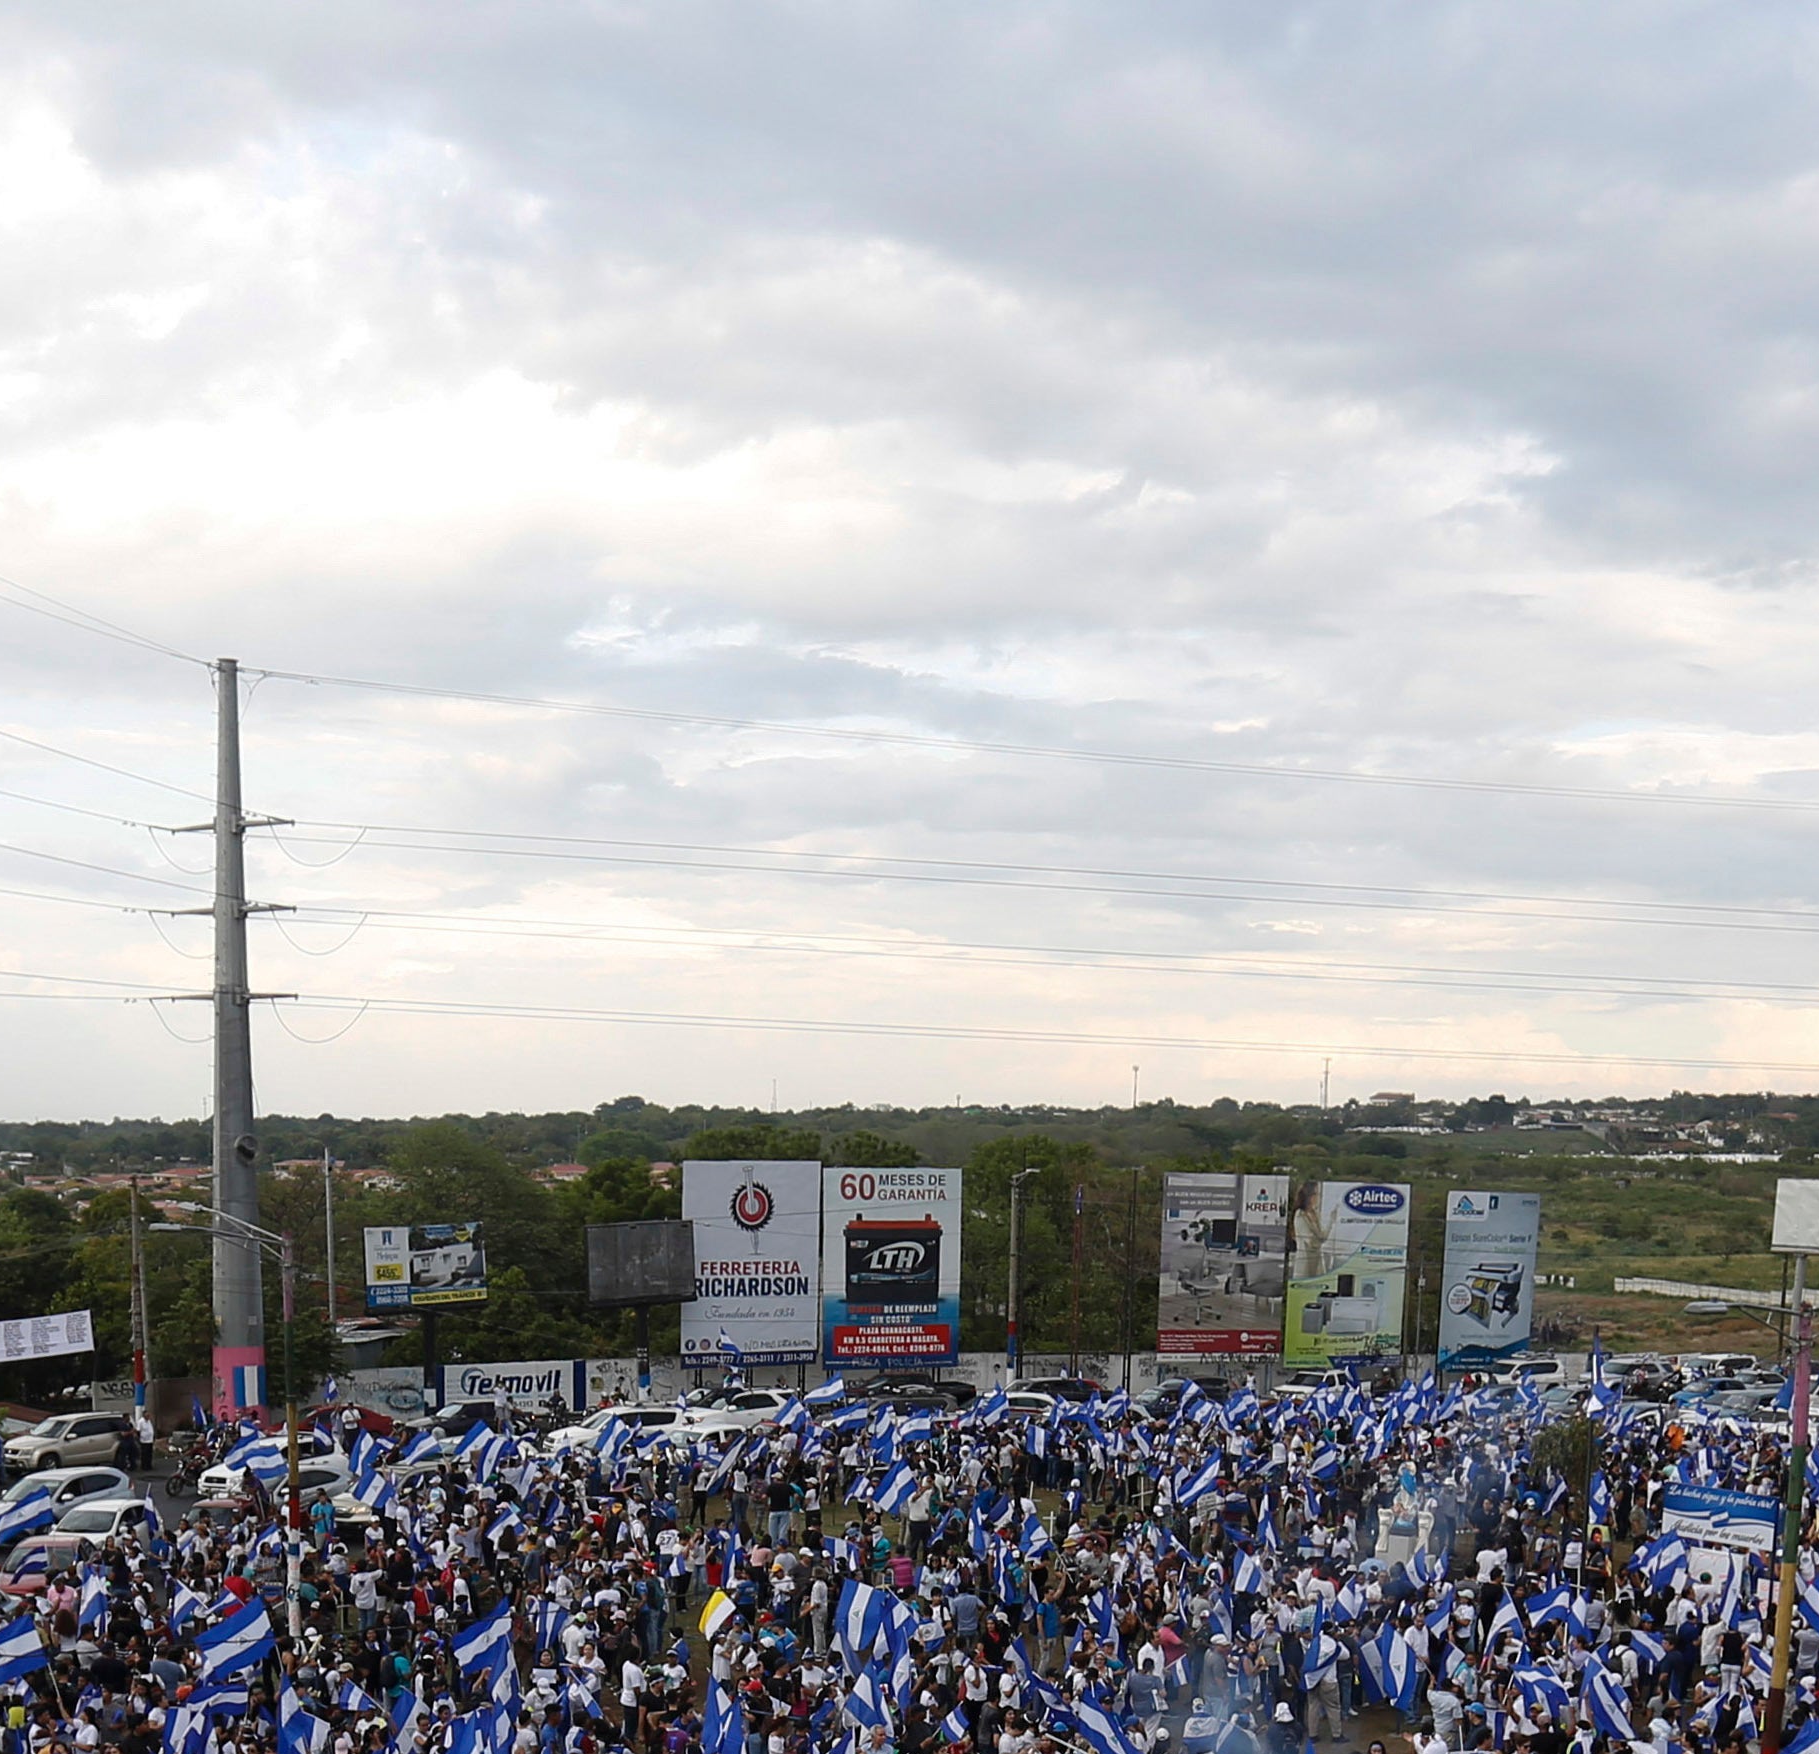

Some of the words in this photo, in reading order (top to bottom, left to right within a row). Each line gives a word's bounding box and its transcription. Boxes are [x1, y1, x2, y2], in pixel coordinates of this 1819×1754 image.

[840, 1173, 876, 1201] 60
[878, 1174, 925, 1187] MESES
[928, 1174, 947, 1187] DE
[877, 1187, 947, 1201] GARANTÍA
[1363, 1190, 1398, 1203] Airtec
[1246, 1202, 1278, 1212] KREA
[869, 1249, 916, 1269] LTH
[700, 1260, 801, 1276] FERRETERIA
[695, 1276, 809, 1298] RICHARDSON
[858, 1327, 879, 1335] PLAZA
